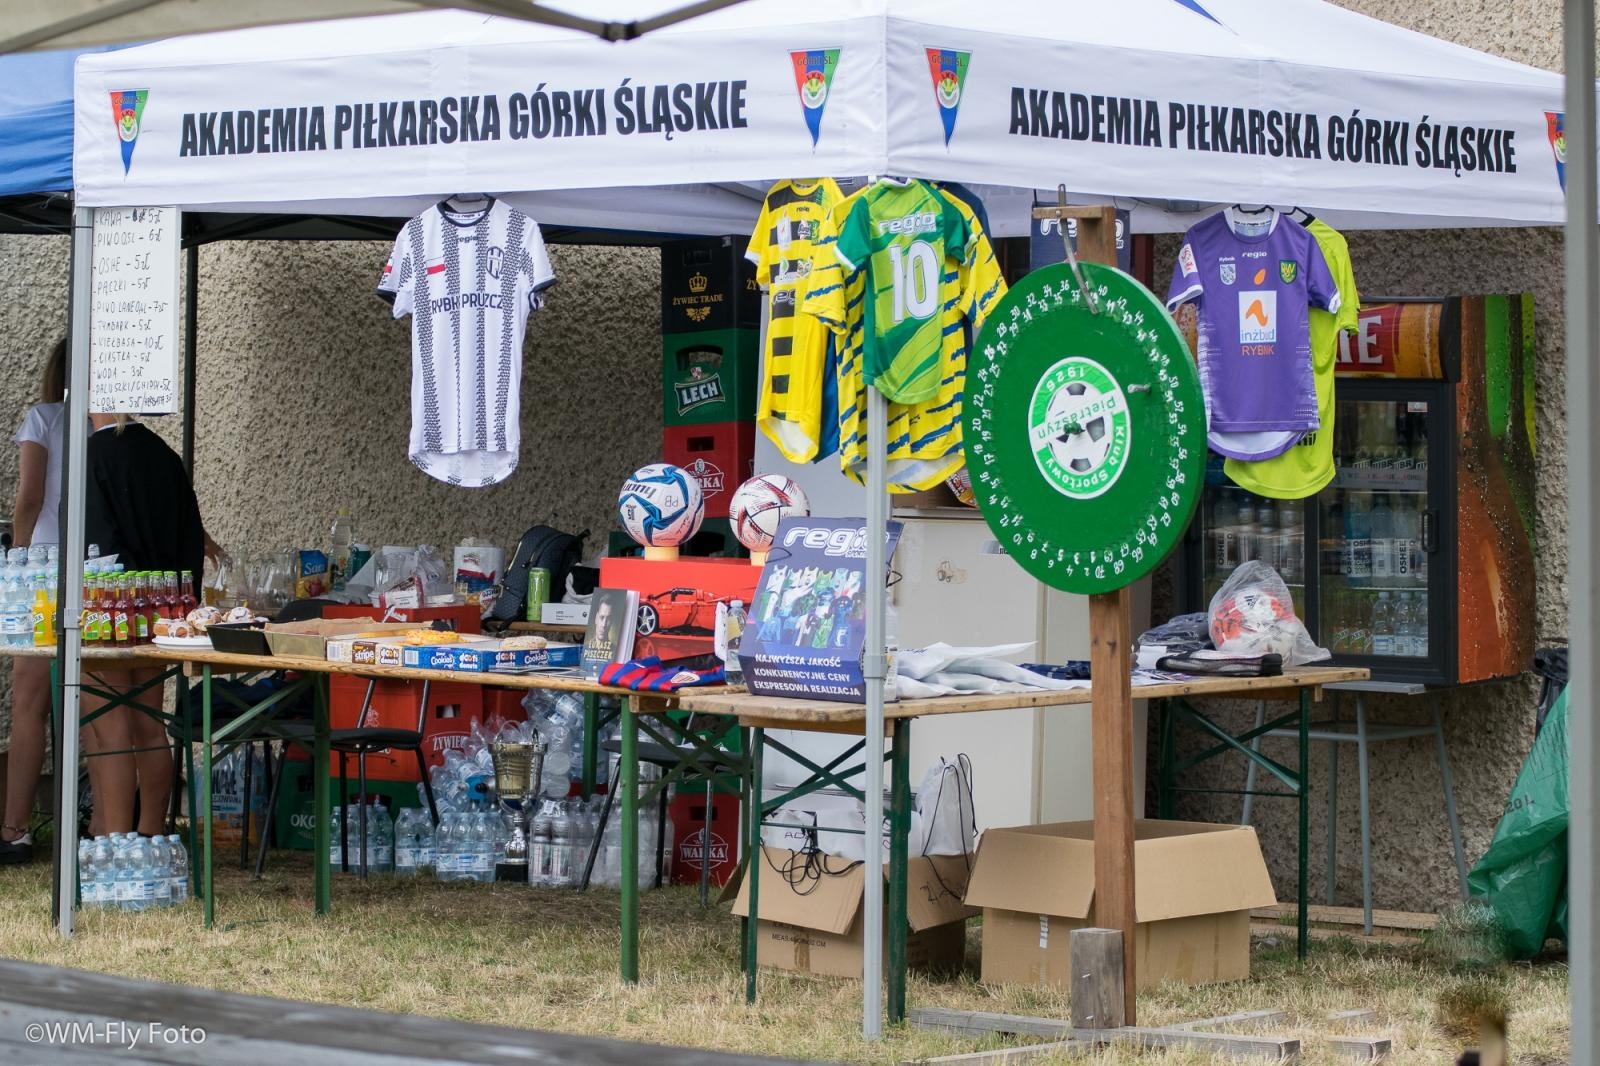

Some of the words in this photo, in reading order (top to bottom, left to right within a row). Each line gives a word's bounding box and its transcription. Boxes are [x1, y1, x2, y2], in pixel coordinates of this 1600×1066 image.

[180, 105, 327, 157] AKADEMIA
[334, 94, 501, 150] PIŁKARSKA
[509, 82, 607, 140] GÓRKI
[615, 77, 748, 140] ŚLĄSKIE
[1008, 86, 1162, 147] AKADEMIA
[1168, 101, 1322, 160] PIŁKARSKA
[1326, 109, 1409, 166] GÓRKI
[1415, 114, 1518, 177] ŚLĄSKIE
[100, 210, 122, 227] KAWA
[879, 211, 936, 236] regio
[1242, 250, 1268, 259] regio
[889, 240, 939, 324] 10
[1060, 280, 1070, 292] 36
[1043, 284, 1052, 298] 34
[1071, 289, 1081, 303] 37
[1098, 284, 1108, 296] 40
[672, 294, 700, 306] ŻYWIEC
[700, 293, 723, 304] TRADE
[1026, 292, 1037, 307] 32
[1053, 292, 1063, 305] 35
[1117, 296, 1127, 310] 42
[1010, 305, 1021, 321] 30
[1106, 299, 1116, 313] 41
[1022, 308, 1032, 323] 31
[1122, 311, 1133, 325] 43
[1134, 310, 1144, 325] 44
[997, 322, 1007, 338] 28
[1009, 322, 1018, 337] 29
[984, 344, 996, 361] 26
[977, 368, 989, 382] 24
[989, 362, 1000, 379] 25
[1169, 375, 1179, 388] 50
[681, 380, 719, 405] LECH
[984, 383, 993, 397] 23
[1165, 390, 1174, 403] 51
[973, 394, 984, 408] 22
[1174, 400, 1184, 412] 52
[982, 408, 992, 420] 21
[1039, 395, 1117, 440] Pietraszyn
[1169, 412, 1177, 424] 53
[972, 418, 981, 431] 20
[1178, 423, 1187, 435] 54
[981, 430, 992, 442] 19
[974, 443, 983, 455] 18
[1108, 425, 1125, 467] Klub
[1178, 446, 1187, 460] 56
[983, 452, 995, 465] 17
[1169, 456, 1179, 470] 57
[980, 471, 990, 482] 16
[1046, 458, 1109, 490] Sportowy
[1175, 468, 1185, 484] 58
[990, 477, 1000, 489] 15
[1166, 475, 1176, 489] 59
[1171, 492, 1180, 506] 60
[1000, 514, 1009, 527] 12
[1160, 512, 1171, 527] 62
[783, 526, 889, 557] regi
[1013, 533, 1023, 545] 10
[1041, 541, 1049, 553] 7
[1121, 543, 1129, 558] 67
[1030, 549, 1037, 560] 8
[1057, 548, 1064, 561] 5
[1074, 552, 1080, 565] 3
[1104, 549, 1113, 563] 69
[1131, 546, 1143, 563] 66
[1048, 559, 1054, 568] 6
[1066, 564, 1074, 577] 4
[1113, 559, 1124, 574] 68
[1084, 567, 1090, 577] 2
[1095, 565, 1105, 579] 70
[431, 654, 456, 666] Cookies
[524, 653, 549, 665] Cookies
[583, 649, 613, 659] PISZCZEK
[755, 653, 806, 666] NAJWYŻSZA
[806, 656, 841, 667] JAKOŚĆ
[754, 668, 827, 681] KONKURENCYJNE
[827, 672, 851, 683] CENY
[754, 680, 810, 693] EKSPRESOWA
[810, 684, 861, 697] REALIZACJA
